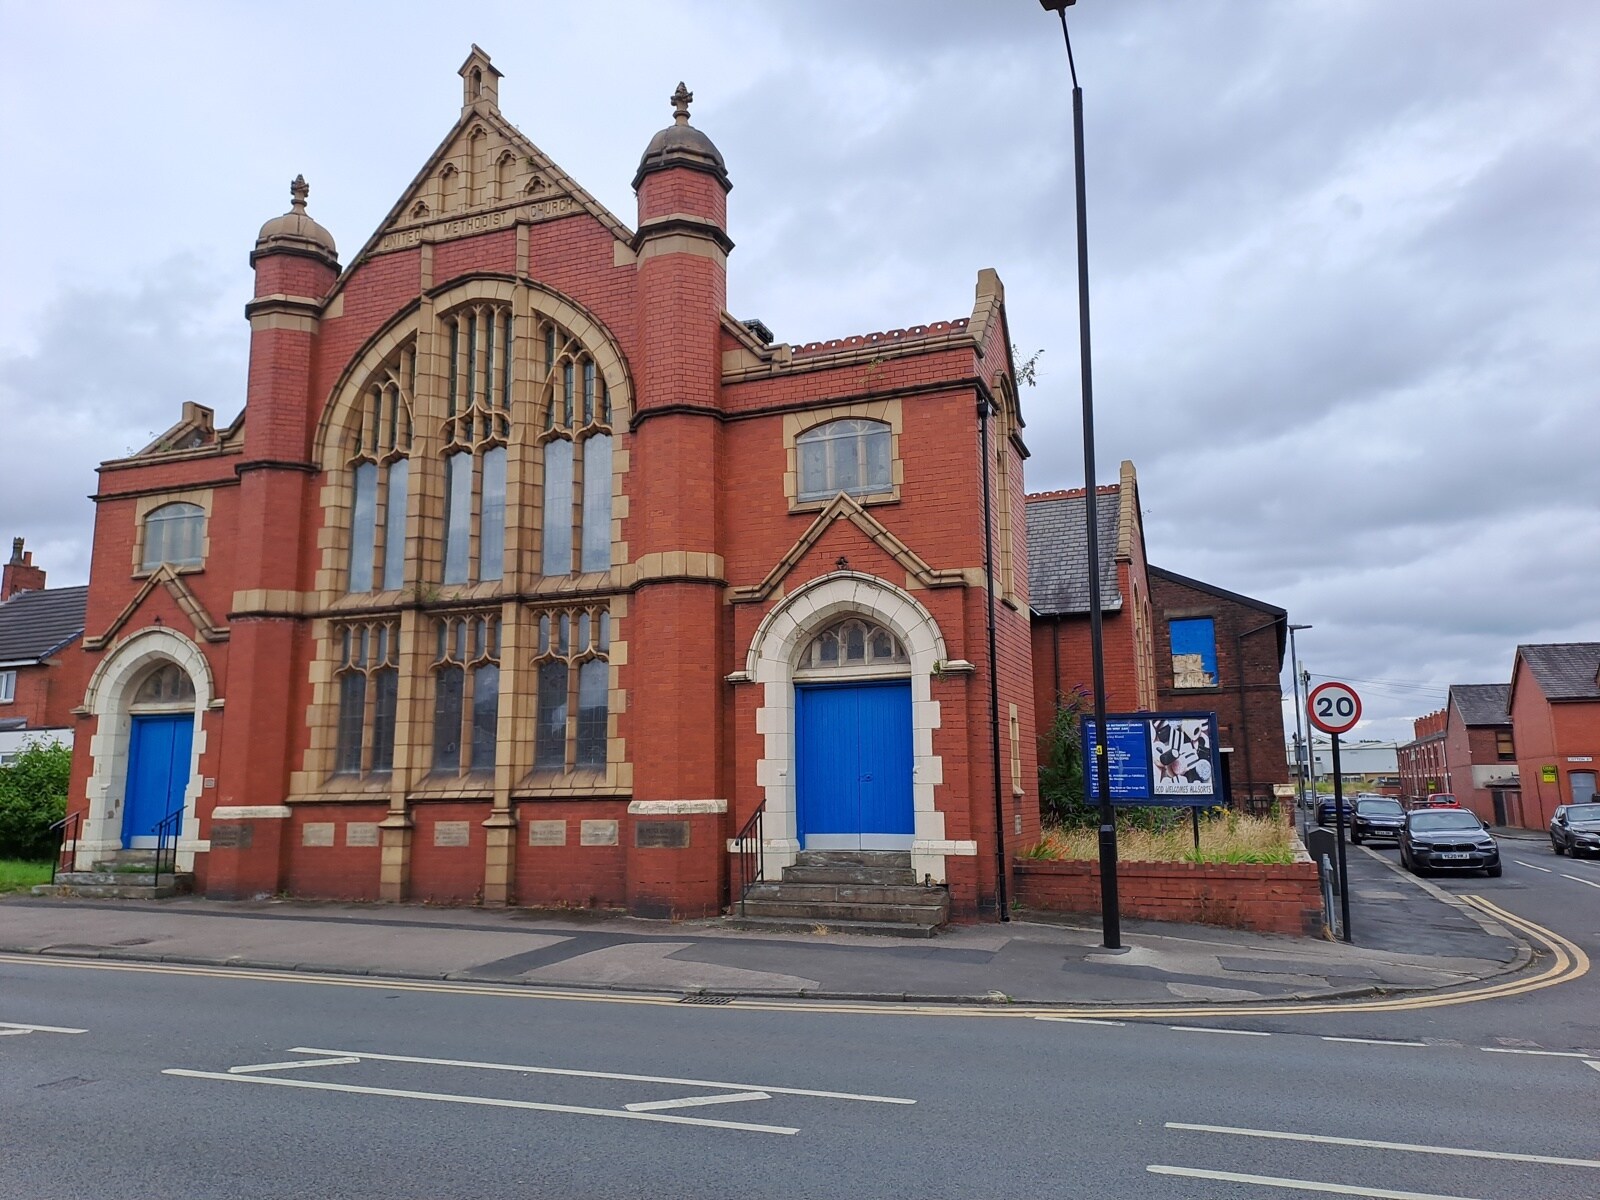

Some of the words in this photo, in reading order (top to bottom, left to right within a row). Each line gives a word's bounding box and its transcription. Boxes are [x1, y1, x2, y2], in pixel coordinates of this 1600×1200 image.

[383, 230, 421, 248] UNITED
[443, 211, 507, 235] METHODIST
[530, 199, 573, 219] CHURCH
[1317, 696, 1354, 717] 20
[1156, 785, 1165, 794] GOD
[1165, 785, 1189, 794] WELCOMES
[1189, 785, 1212, 794] ALLSORTS
